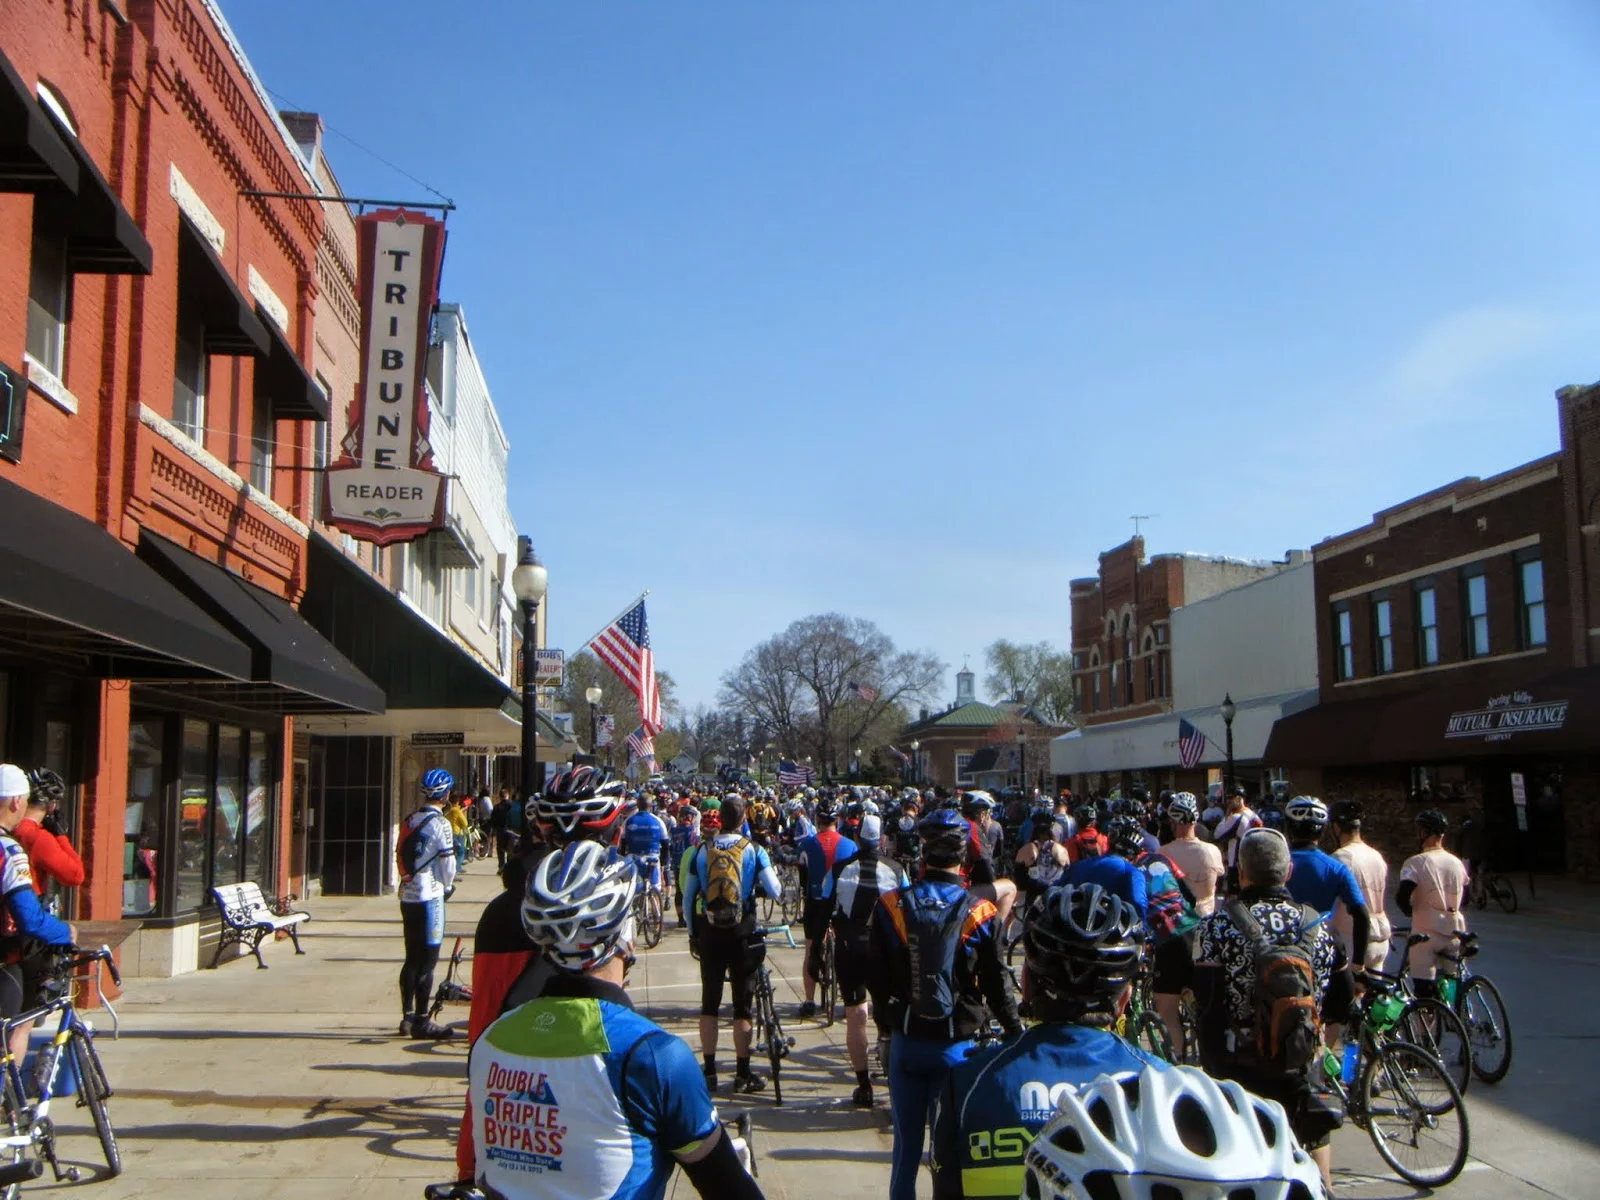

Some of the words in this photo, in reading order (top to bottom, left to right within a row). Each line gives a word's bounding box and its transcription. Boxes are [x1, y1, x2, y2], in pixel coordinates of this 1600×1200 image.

[374, 249, 411, 470] TRIBUNE
[345, 484, 424, 501] READER
[1446, 714, 1492, 732] MUTUAL
[1498, 705, 1568, 727] INSURANCE
[1269, 912, 1284, 932] 6
[486, 1061, 548, 1096] DOUBLE
[487, 1092, 559, 1129] TRIPLE
[484, 1116, 563, 1156] BYPASS
